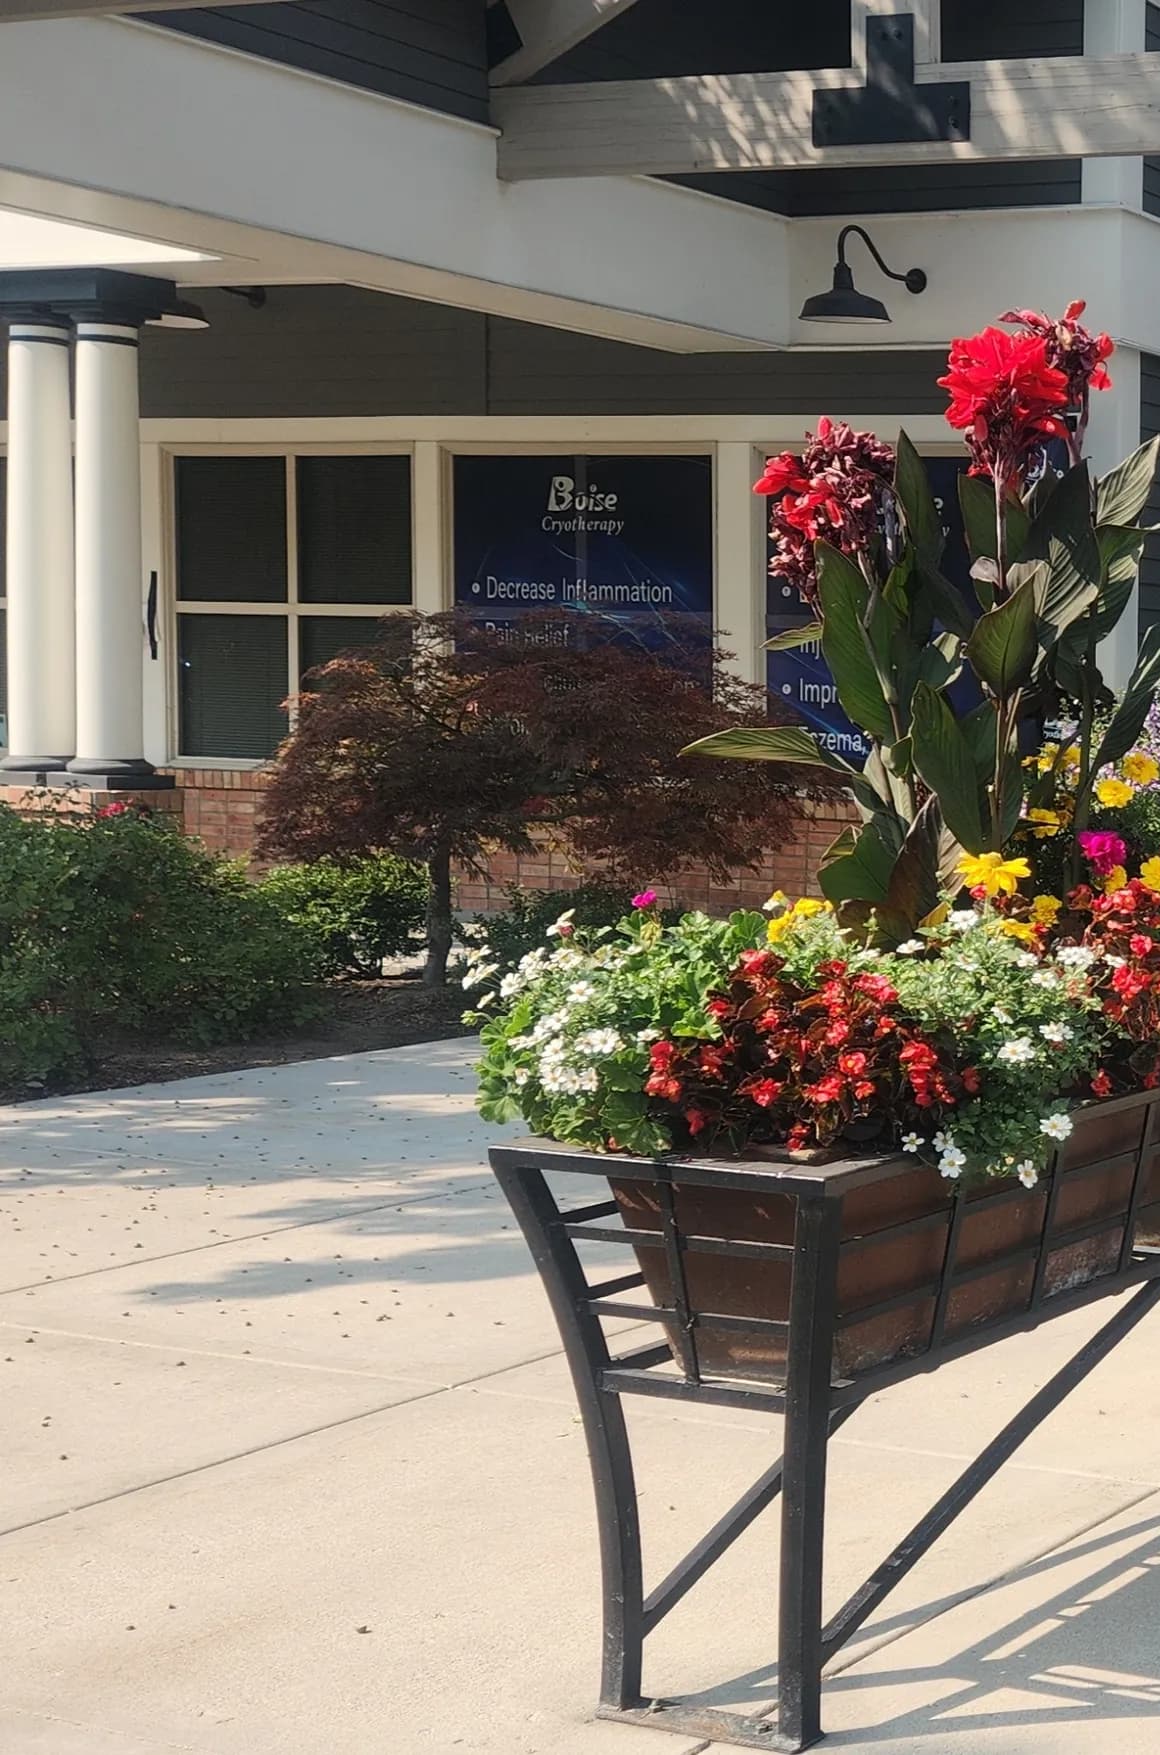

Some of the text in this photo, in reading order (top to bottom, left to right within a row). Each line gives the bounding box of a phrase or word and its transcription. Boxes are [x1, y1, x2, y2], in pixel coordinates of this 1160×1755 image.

[547, 475, 618, 512] Boise
[541, 515, 625, 536] Cryotherapy
[486, 576, 673, 603] Decrease Inflammation
